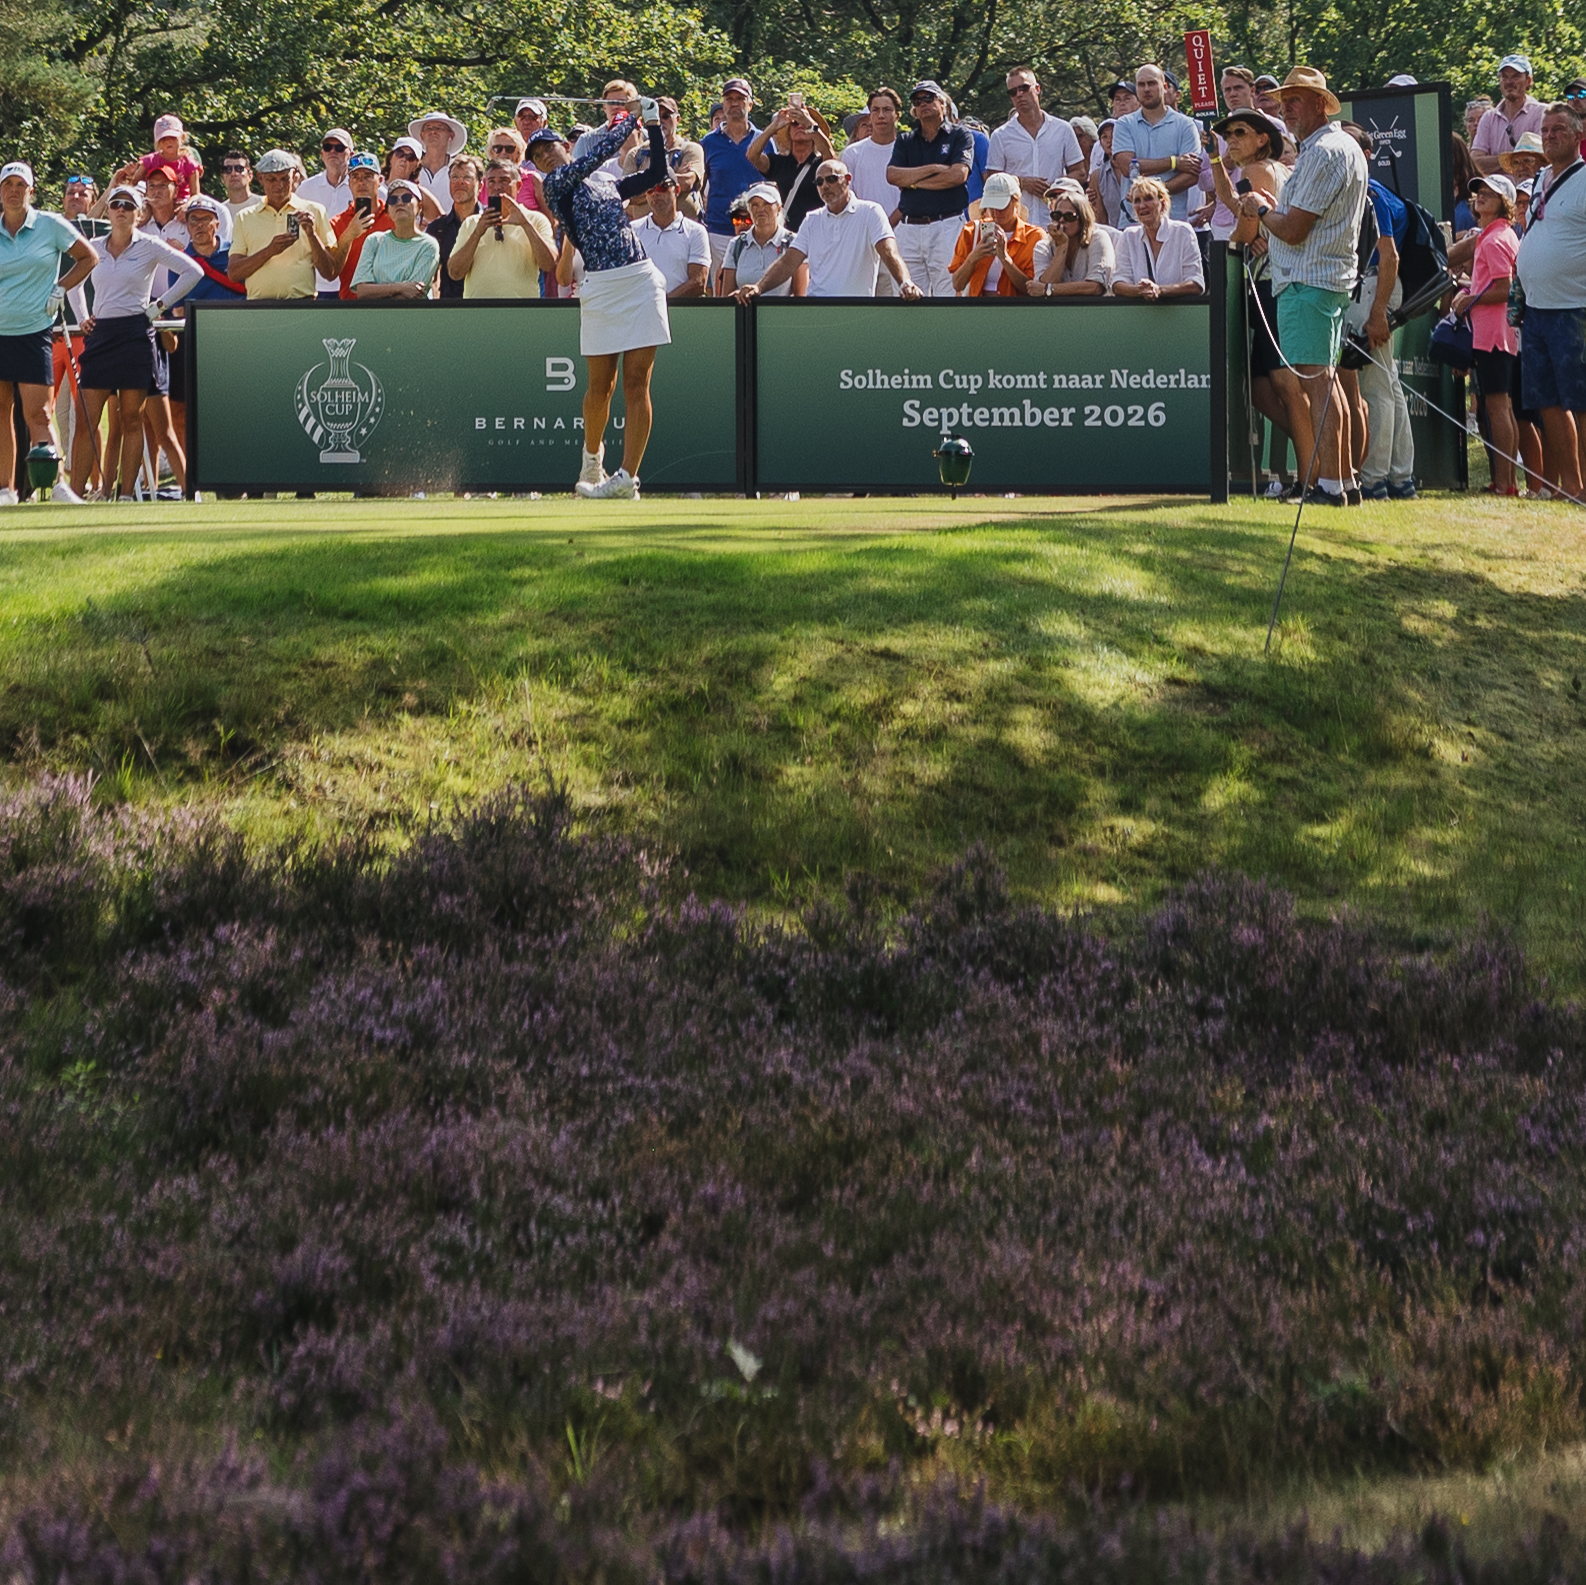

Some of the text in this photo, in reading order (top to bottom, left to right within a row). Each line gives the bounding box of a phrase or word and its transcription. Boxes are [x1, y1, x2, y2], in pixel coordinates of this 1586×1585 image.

[1192, 35, 1207, 98] QUIET
[1394, 128, 1407, 140] Egg
[839, 368, 933, 389] Solheim
[938, 369, 983, 394] Cup
[988, 369, 1047, 389] komt
[1052, 373, 1105, 389] naar
[310, 390, 369, 403] SOLHEIM
[325, 403, 353, 415] CUP
[902, 399, 1166, 435] September 2026
